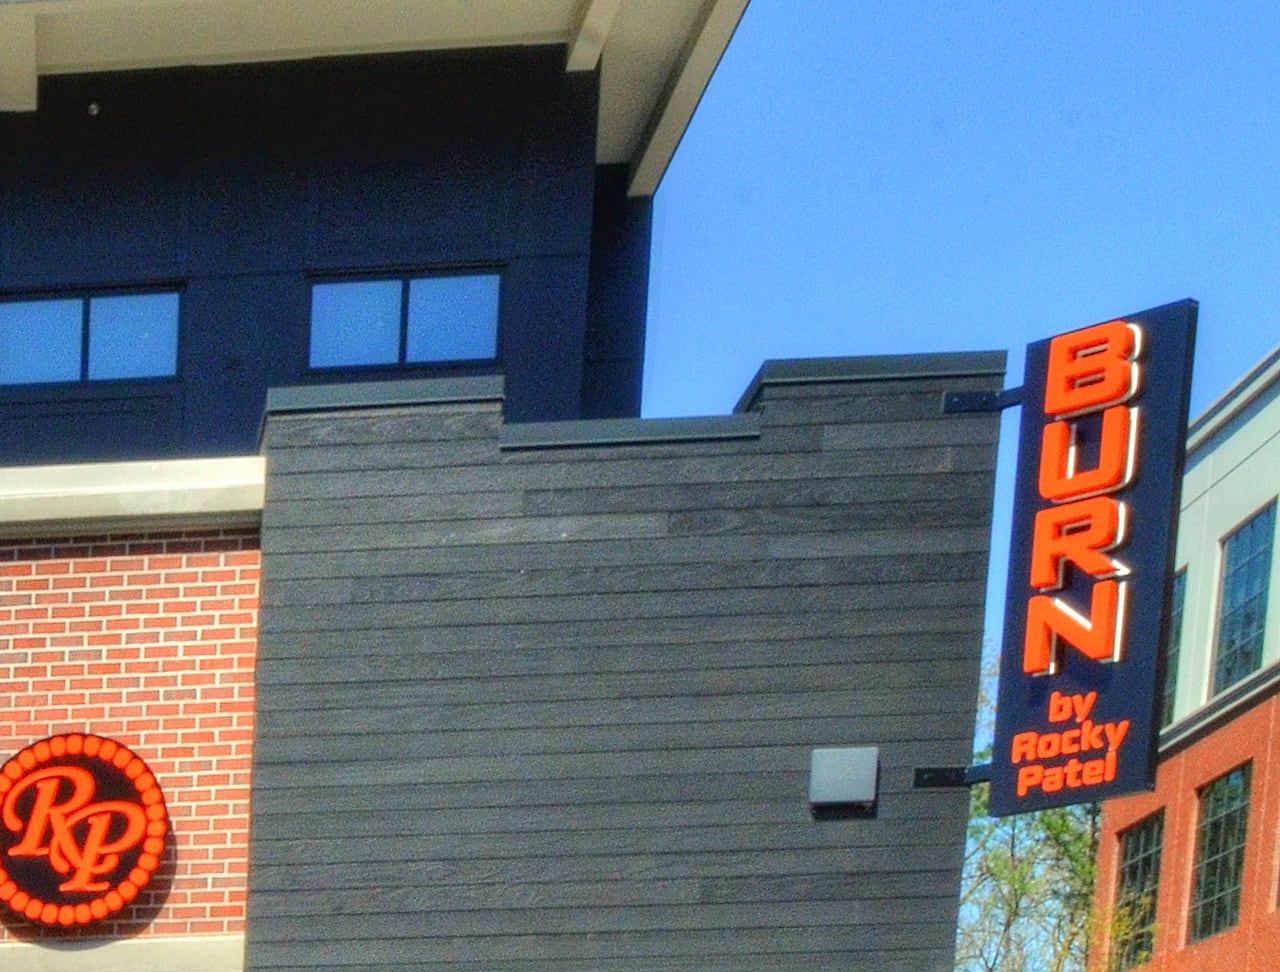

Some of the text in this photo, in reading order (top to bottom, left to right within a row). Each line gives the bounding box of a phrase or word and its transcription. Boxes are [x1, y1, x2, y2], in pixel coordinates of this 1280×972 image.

[1023, 319, 1142, 675] BURN
[1048, 691, 1098, 722] by
[1011, 719, 1131, 764] Rocky
[1016, 752, 1118, 797] Patel
